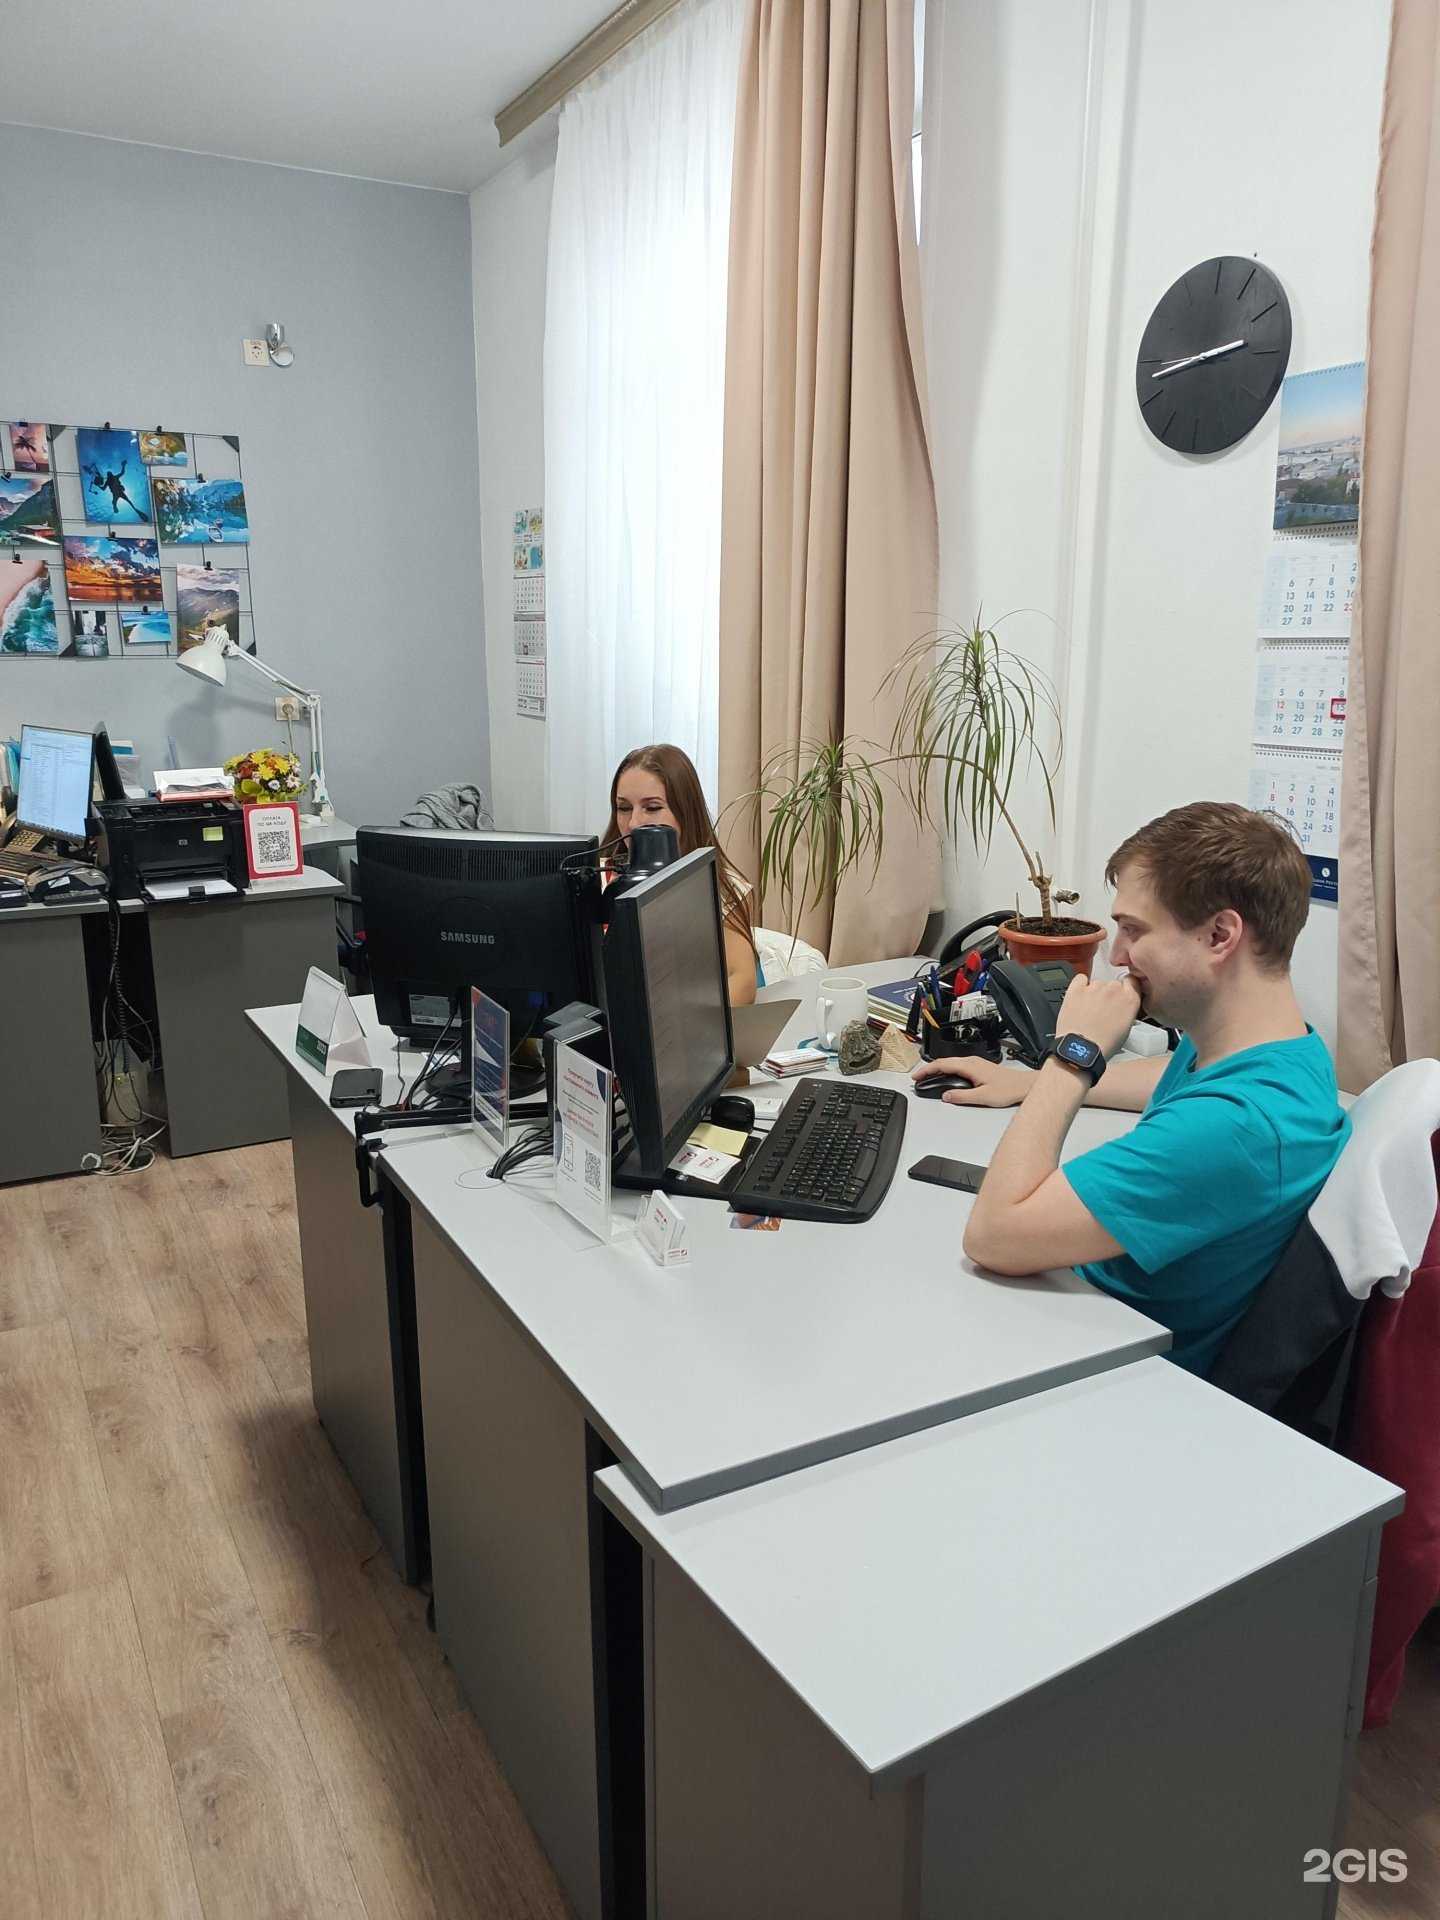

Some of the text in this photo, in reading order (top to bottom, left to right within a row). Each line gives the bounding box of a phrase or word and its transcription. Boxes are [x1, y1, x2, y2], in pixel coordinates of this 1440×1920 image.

[1351, 562, 1357, 572] 2
[1288, 575, 1356, 588] 6 7 8 9
[1306, 591, 1315, 600] 14
[1325, 590, 1335, 599] 15
[1323, 602, 1334, 612] 22
[1281, 616, 1312, 626] 27 28
[1279, 688, 1285, 697] 5
[1298, 688, 1305, 698] 6
[1318, 689, 1325, 698] 7
[1277, 701, 1285, 709] 12
[1316, 702, 1325, 711] 14
[1336, 703, 1345, 712] 15
[1275, 713, 1284, 722] 19
[1293, 713, 1305, 722] 20
[1313, 714, 1323, 724] 21
[1272, 724, 1344, 737] 26 27 28 29
[1289, 783, 1296, 792] 2
[1309, 784, 1315, 793] 3
[1328, 787, 1335, 795] 4
[1288, 795, 1295, 803] 9
[1307, 797, 1316, 806] 10
[1327, 799, 1334, 808] 11
[1286, 807, 1295, 816] 16
[1306, 809, 1314, 818] 17
[1325, 812, 1334, 821] 18
[1303, 822, 1333, 833] 24 25
[440, 931, 496, 945] SAMSUNG
